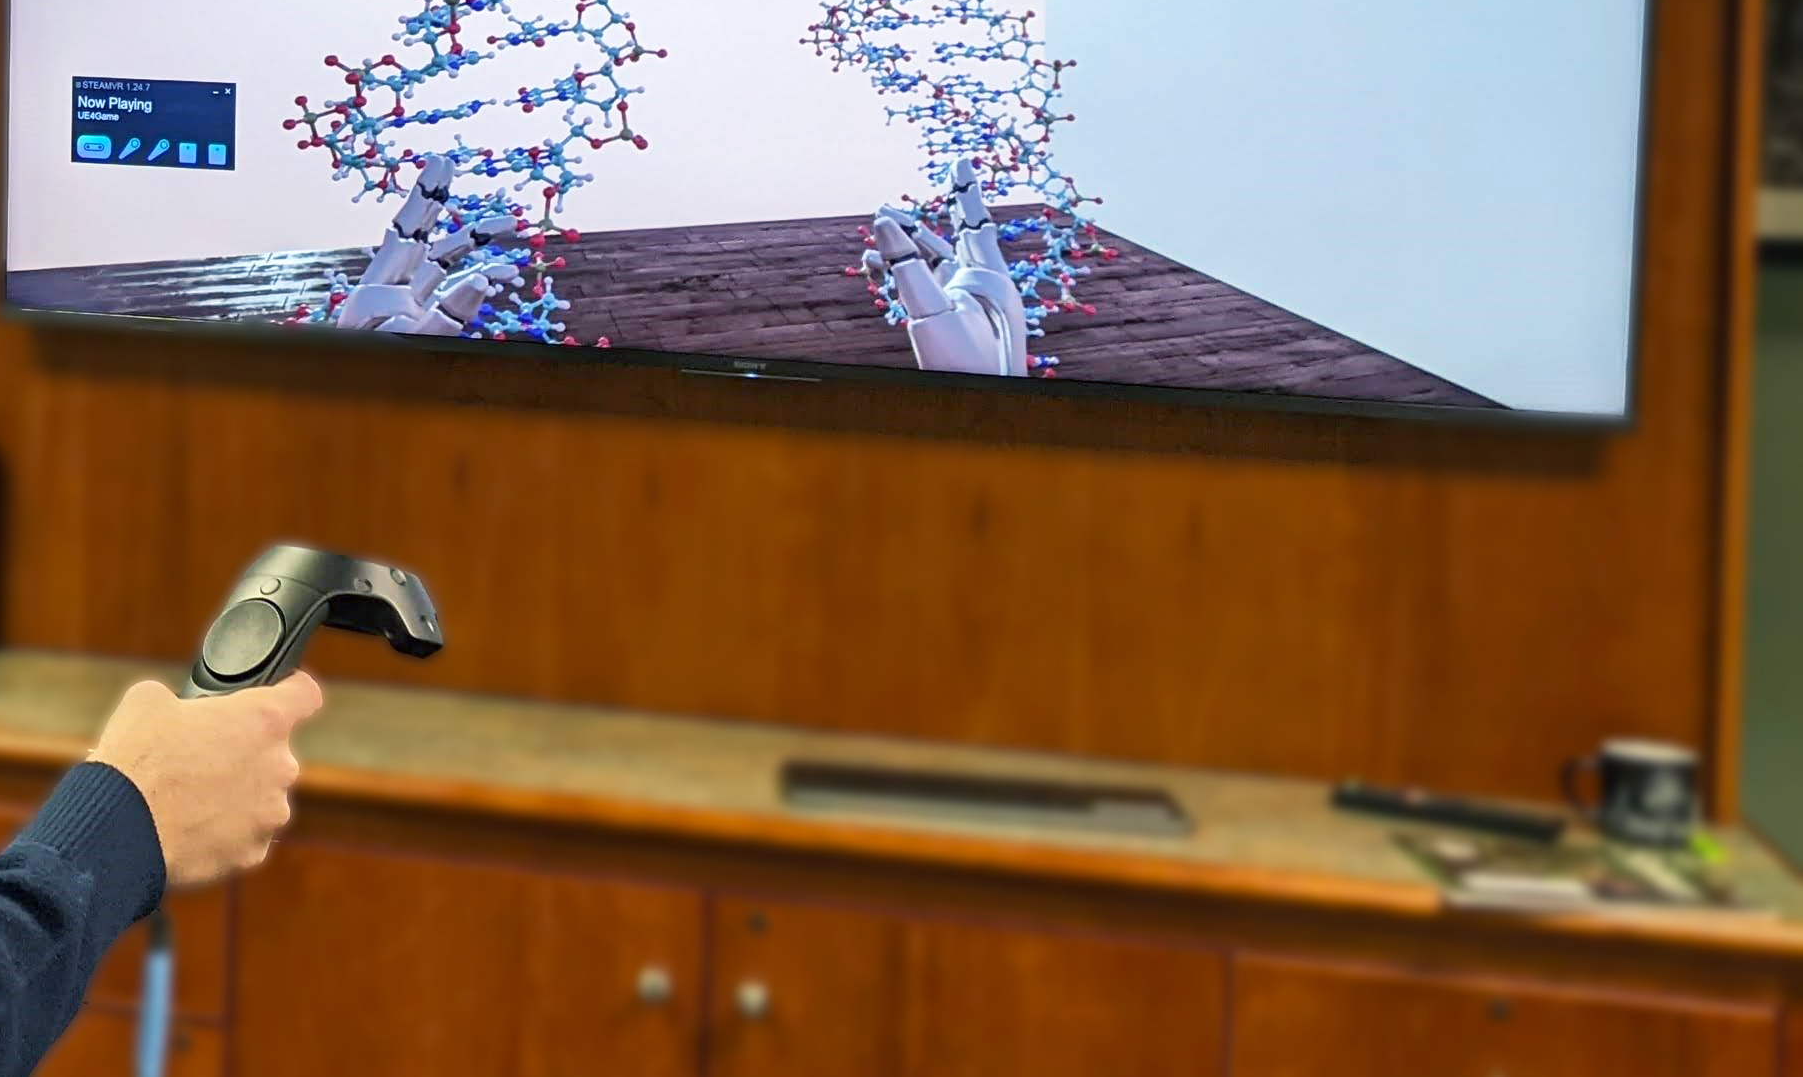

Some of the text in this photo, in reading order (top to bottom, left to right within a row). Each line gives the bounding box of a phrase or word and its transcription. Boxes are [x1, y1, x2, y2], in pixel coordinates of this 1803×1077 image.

[82, 80, 150, 91] STEAMVR 1.24.7
[77, 95, 153, 113] Now Playing
[77, 111, 119, 121] UE4Game
